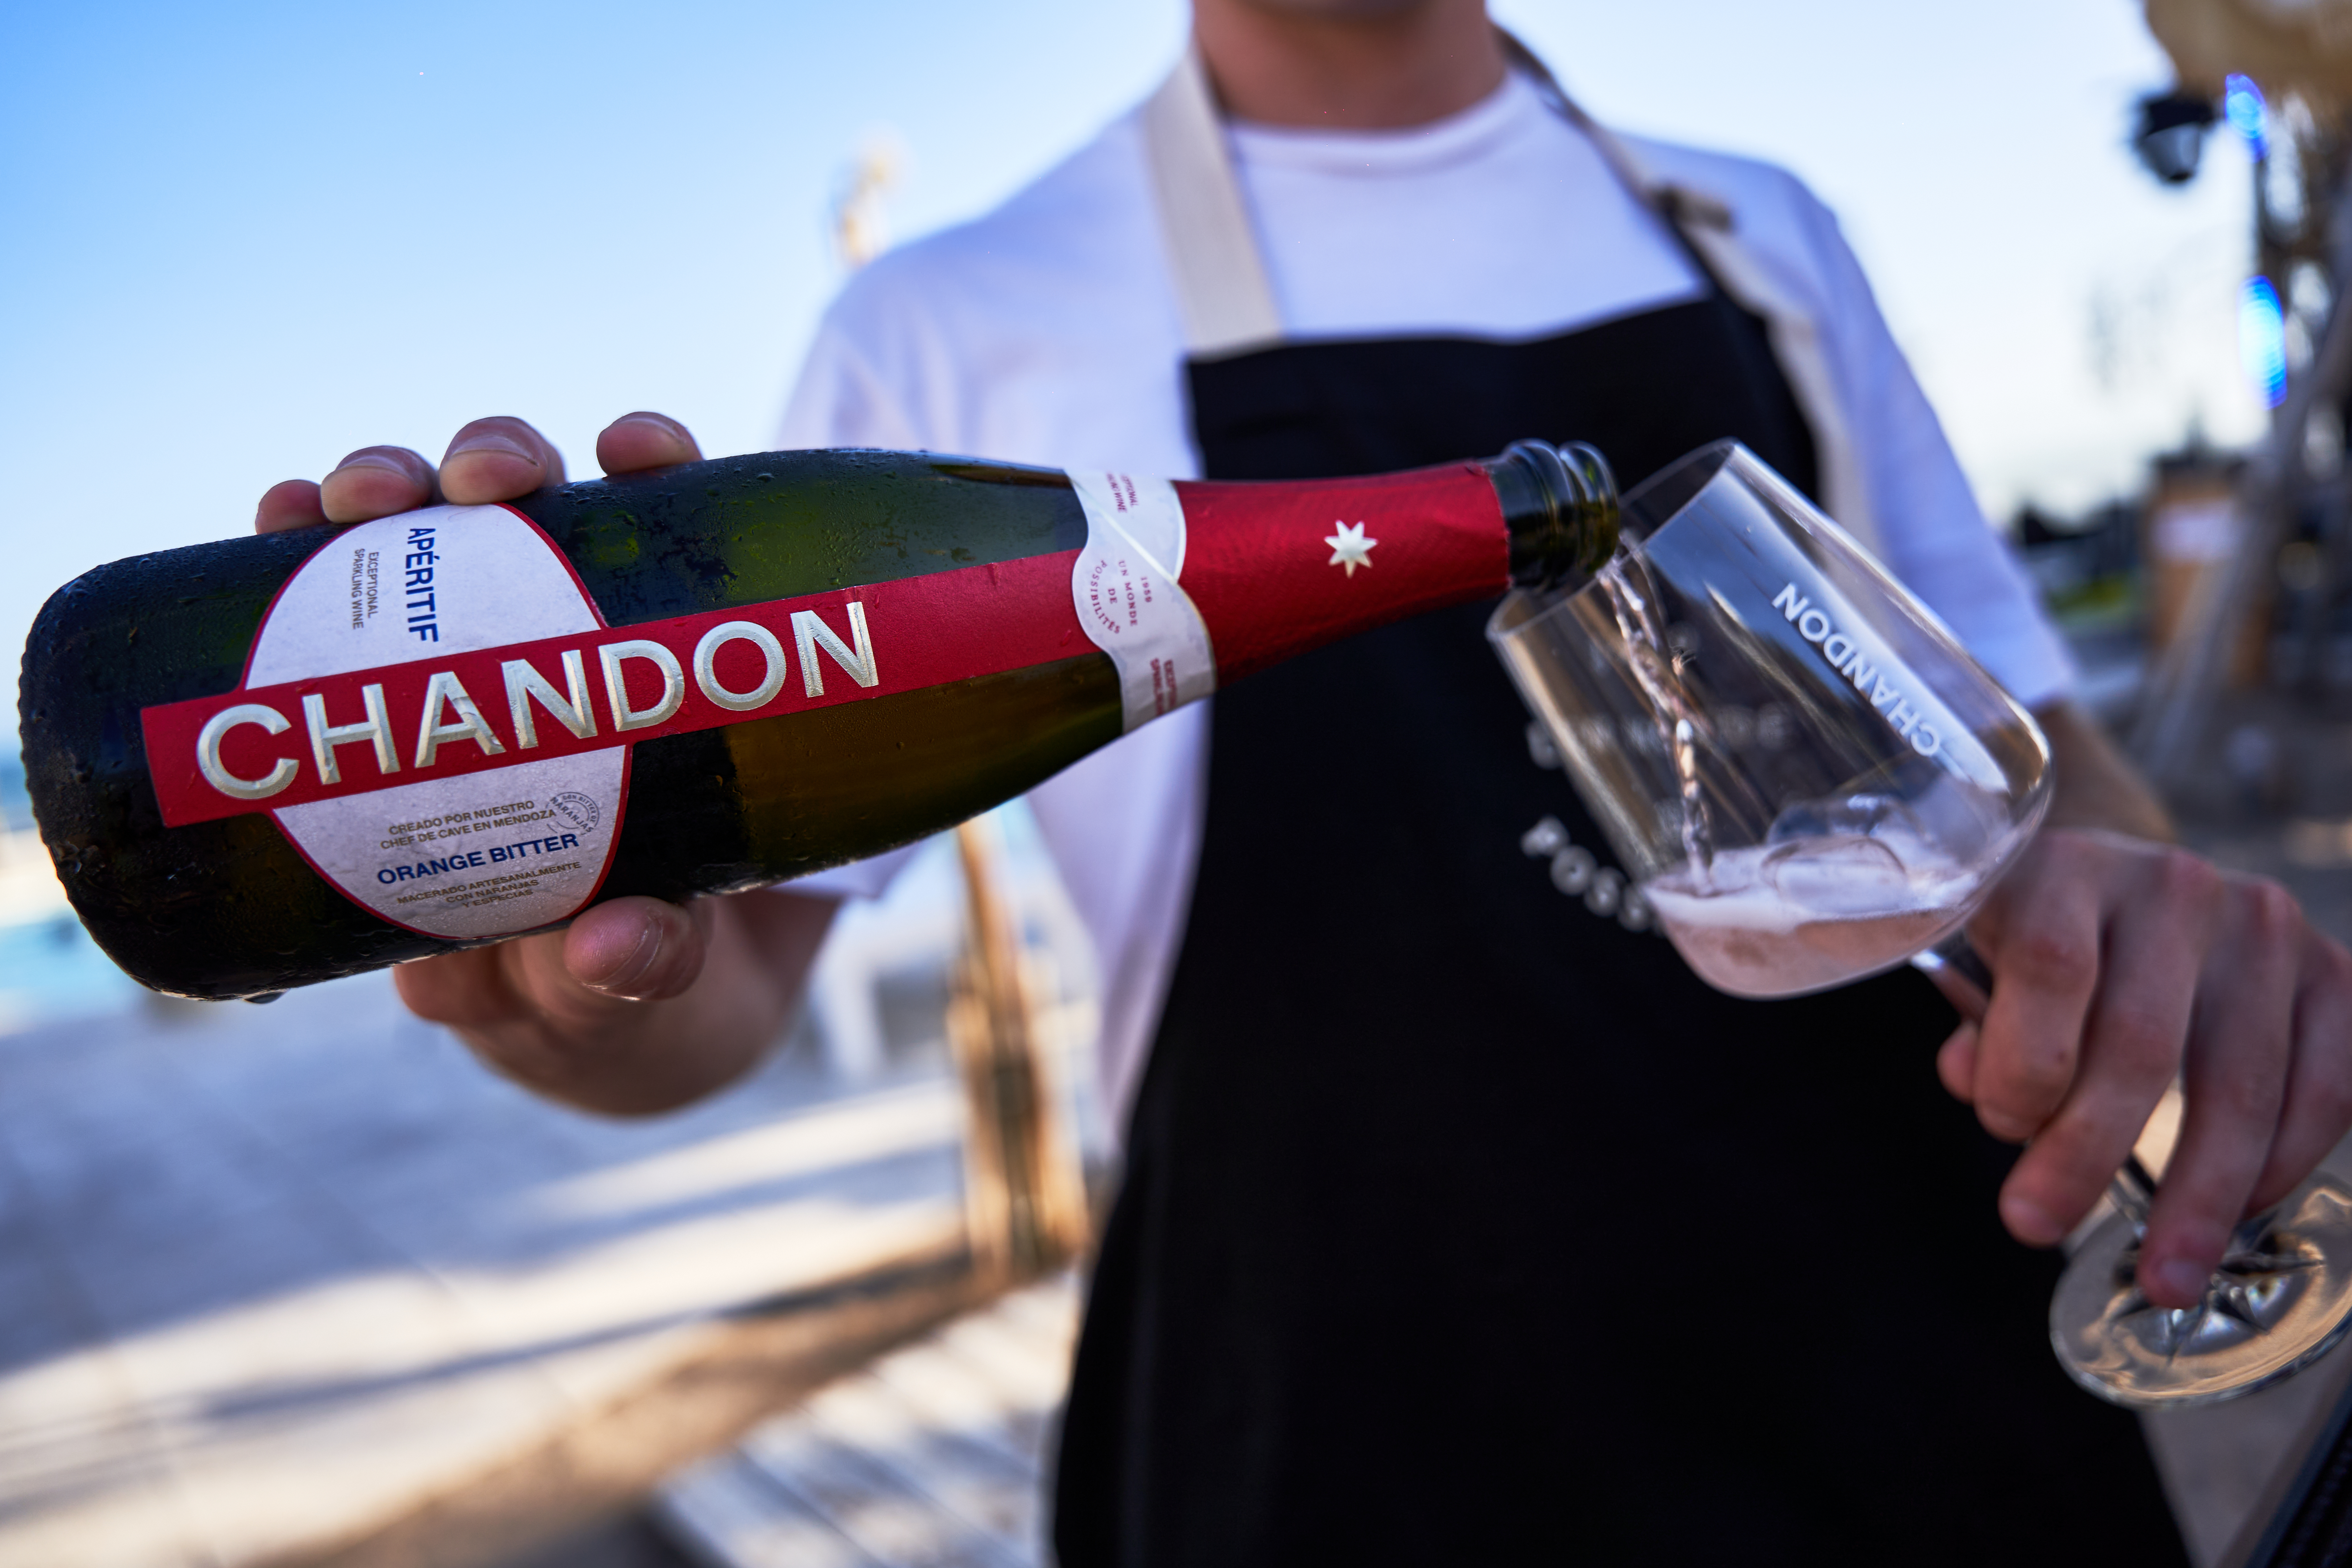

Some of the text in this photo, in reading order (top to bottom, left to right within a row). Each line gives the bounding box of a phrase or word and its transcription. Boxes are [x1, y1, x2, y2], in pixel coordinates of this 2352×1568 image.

[351, 548, 365, 630] SPARKLING WINE
[367, 552, 379, 618] EXCEPTIONAL
[405, 528, 440, 642] APÉRITIF
[1108, 588, 1118, 604] DE
[1118, 561, 1138, 626] UN MONDE
[1771, 582, 1940, 757] CHANDON
[196, 601, 879, 800] CHANDON
[388, 800, 535, 835] CREADO POR NUESTRO
[550, 797, 594, 833] NARANJAS
[579, 796, 597, 813] BITTER
[380, 809, 557, 849] CHEF DE CAVE EN MENDOZA
[377, 833, 579, 884] ORANGE BITTER
[397, 862, 582, 904] MACERADO ARTESANALMENTE
[446, 879, 539, 902] CON NARANJAS
[472, 889, 534, 906] ESPECIAS
